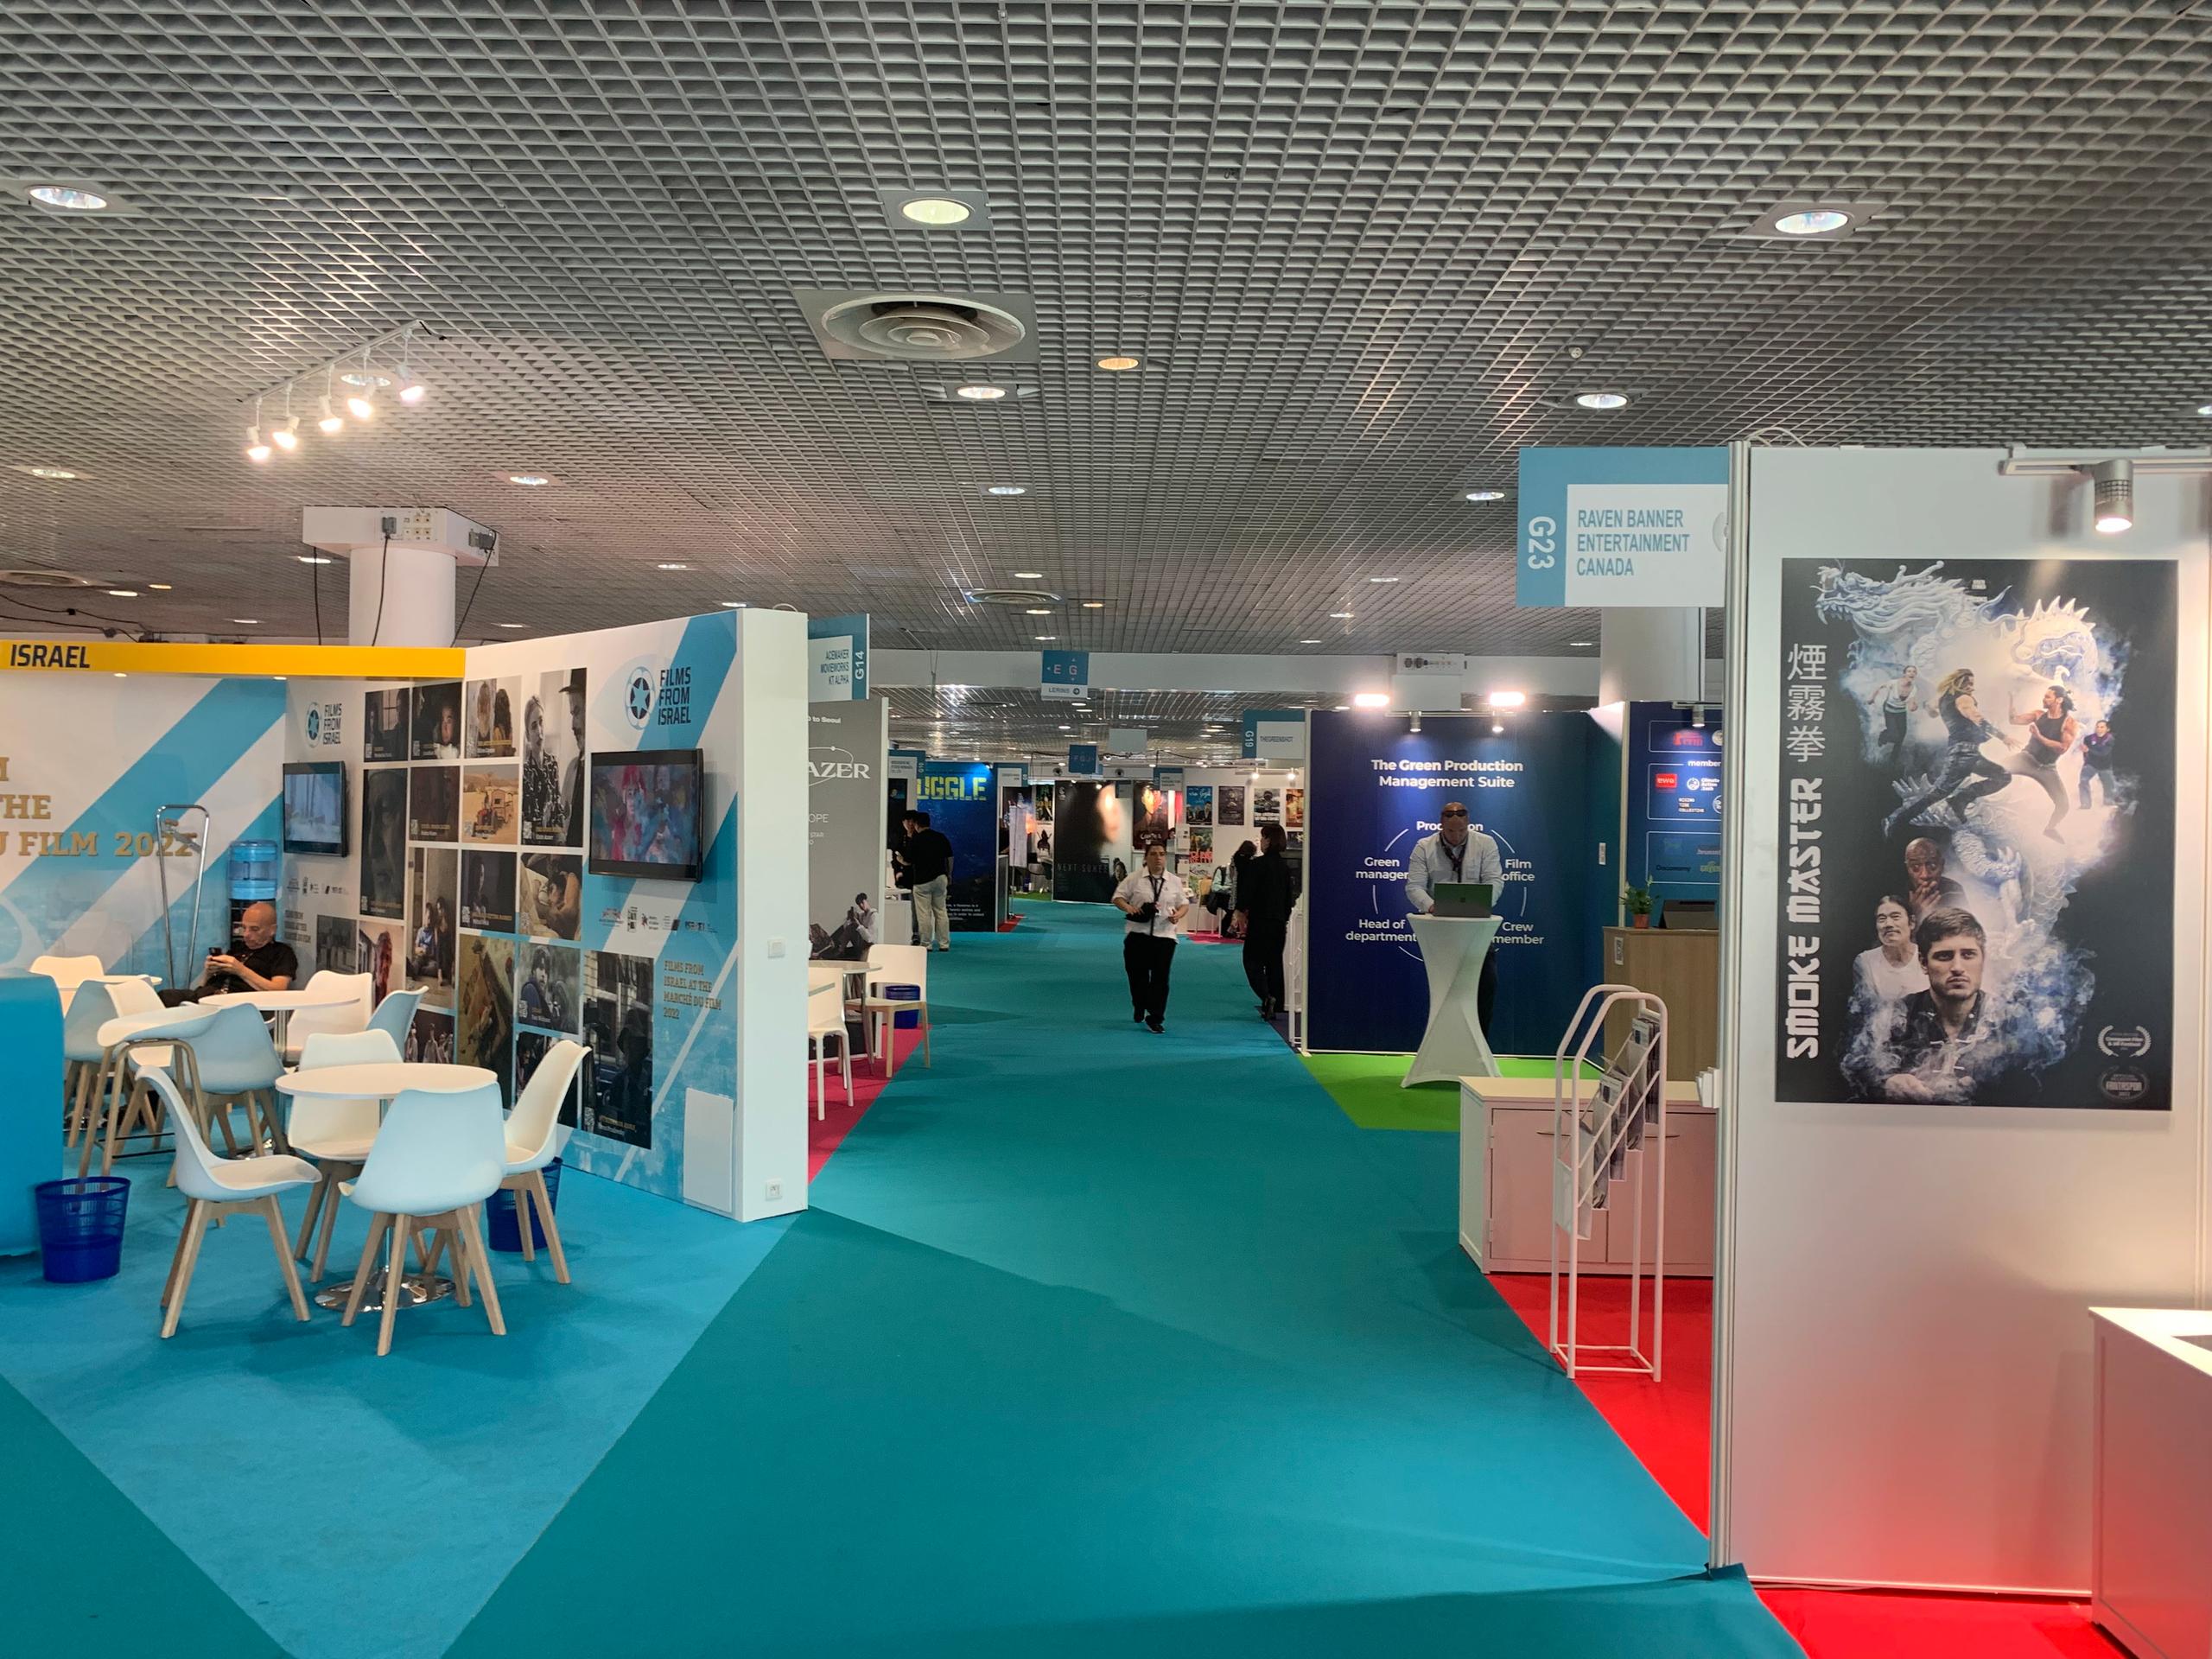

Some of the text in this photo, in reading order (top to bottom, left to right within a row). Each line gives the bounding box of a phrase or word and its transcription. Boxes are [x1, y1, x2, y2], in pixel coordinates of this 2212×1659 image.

[1578, 510, 1684, 528] RAVEN BANNER
[1528, 516, 1556, 570] G23
[1577, 534, 1690, 552] ENTERTAINMENT
[1577, 558, 1634, 576] CANADA
[10, 644, 91, 669] ISRAEL
[855, 651, 864, 680] G14
[659, 667, 691, 687] FILMS
[658, 686, 690, 706] FROM
[1786, 643, 1827, 763] 煙霧拳
[324, 703, 342, 717] FILMS
[658, 706, 691, 726] ISRAEL
[323, 718, 341, 731] FROM
[322, 732, 341, 745] ISRAEL
[1371, 760, 1523, 772] The Green Production
[1379, 776, 1515, 790] Management Suite
[19, 832, 99, 856] FILM
[1364, 857, 1400, 868] Green
[1505, 859, 1532, 869] Film
[1356, 869, 1409, 880] manager
[1501, 871, 1535, 881] office
[1359, 918, 1406, 930] Head of
[1786, 778, 1822, 1059] SMOKE MASTER
[1502, 922, 1534, 932] Crew
[1345, 931, 1417, 943] department
[1491, 934, 1544, 945] member
[664, 961, 704, 976] FILMS FROM
[664, 976, 713, 993] ISRAEL AT THE
[693, 995, 704, 1007] DU
[705, 997, 722, 1010] FILM
